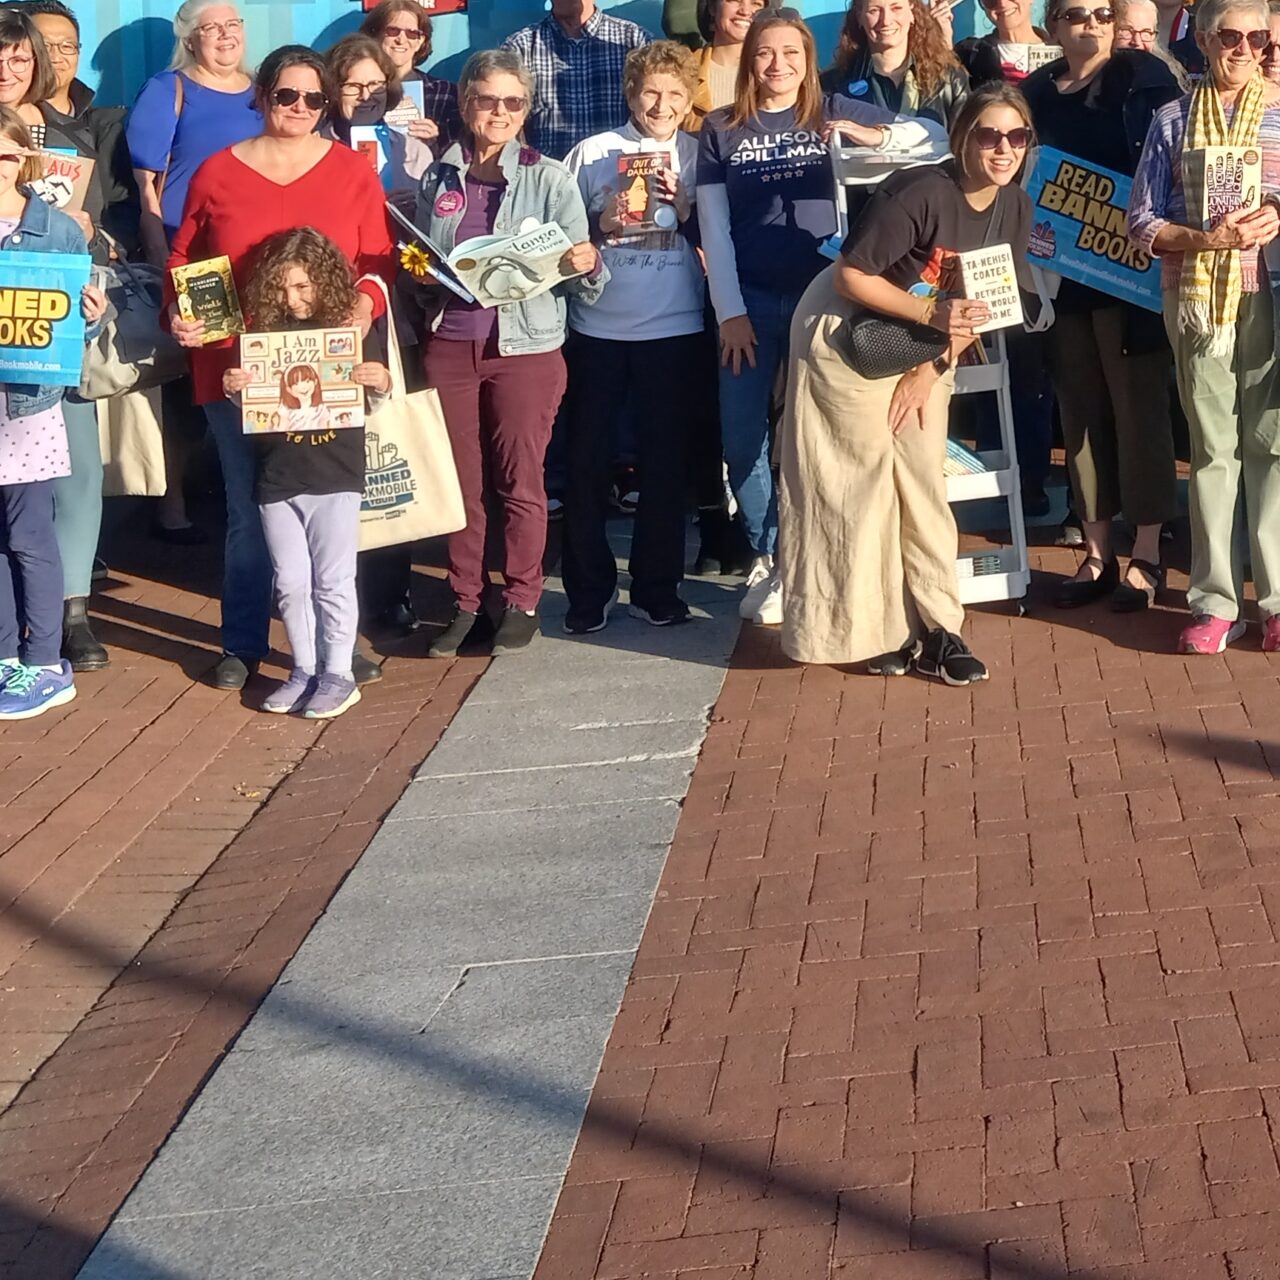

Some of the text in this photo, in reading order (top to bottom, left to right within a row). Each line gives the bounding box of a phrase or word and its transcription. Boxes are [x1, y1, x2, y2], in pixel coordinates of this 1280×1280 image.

[737, 130, 823, 151] ALLISON
[632, 158, 649, 168] OUT
[729, 142, 831, 166] SPILLMAN
[47, 159, 82, 182] AUS
[1056, 162, 1114, 202] READ
[1039, 182, 1129, 238] BANN
[1077, 225, 1150, 271] BOOKS
[973, 265, 1007, 280] COATES
[974, 284, 1012, 300] BETWEEN
[990, 295, 1017, 308] WORLD
[1000, 308, 1012, 319] ME
[283, 336, 317, 348] I Am
[271, 348, 321, 368] Jazz
[311, 430, 336, 446] LIVE
